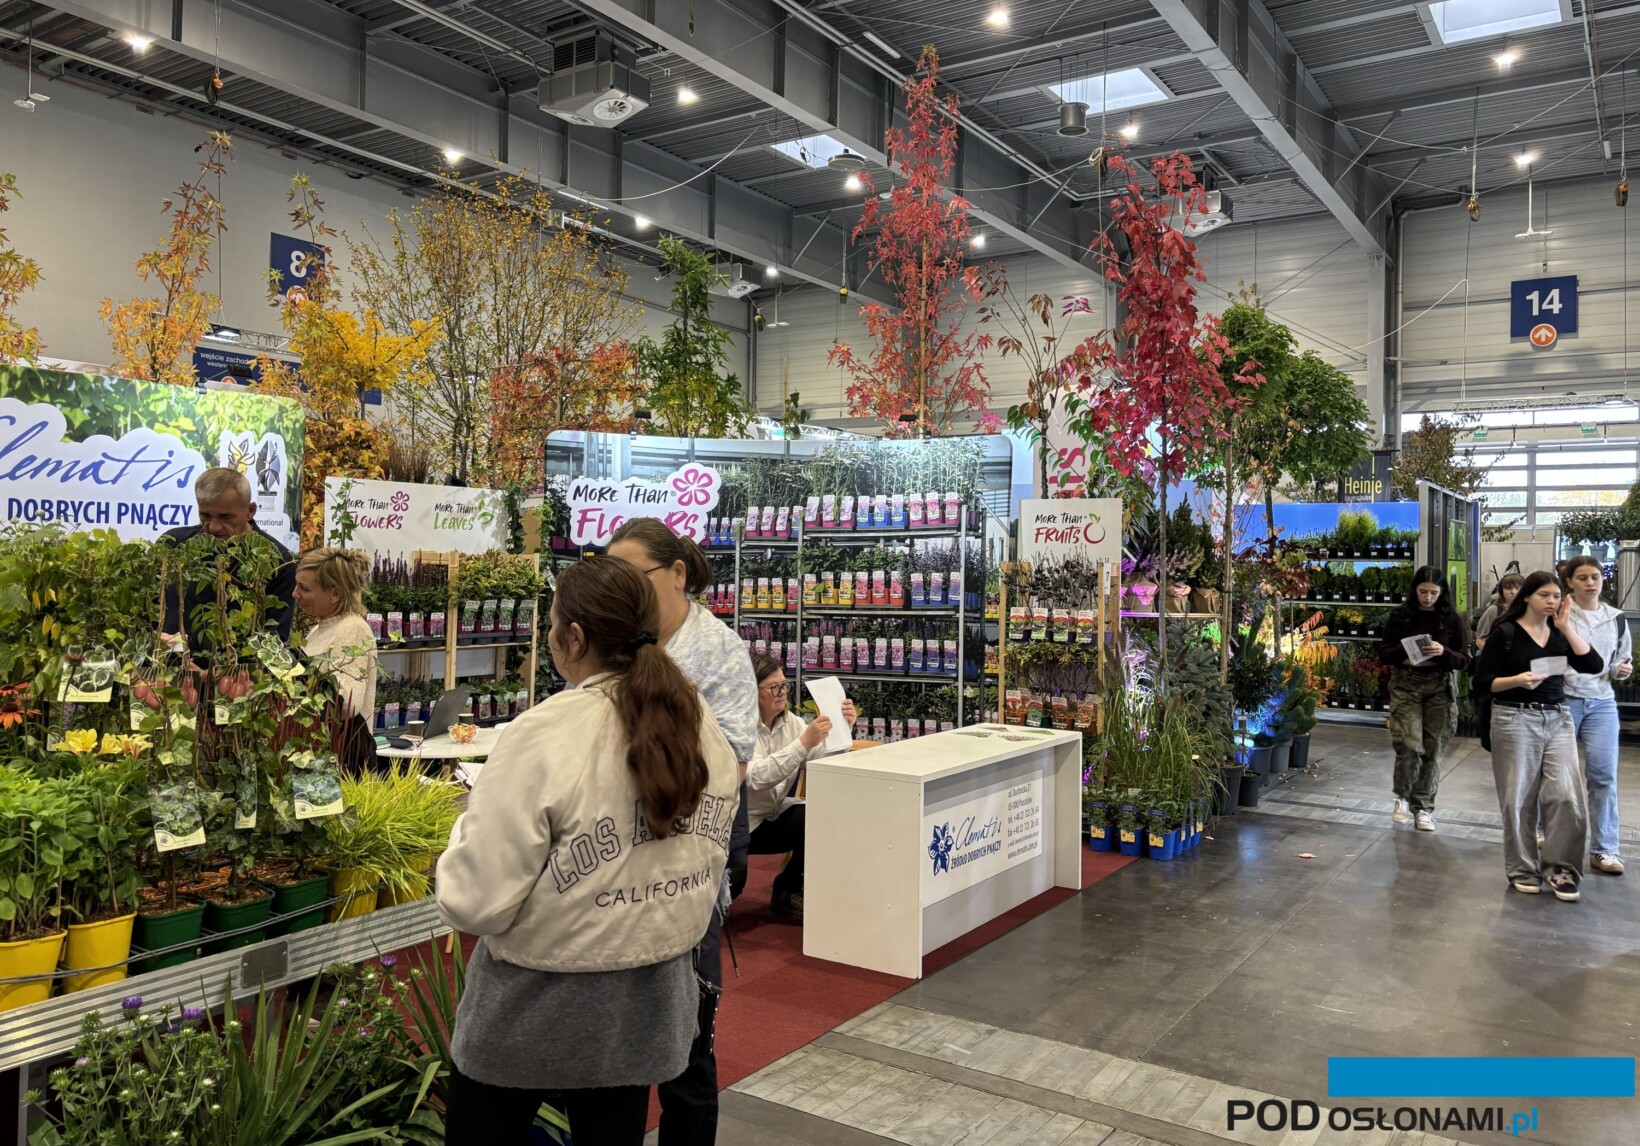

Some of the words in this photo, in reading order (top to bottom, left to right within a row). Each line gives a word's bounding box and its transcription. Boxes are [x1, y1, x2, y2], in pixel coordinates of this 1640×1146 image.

[289, 250, 307, 278] 8
[1525, 288, 1563, 316] 14
[225, 356, 250, 365] zachod
[0, 415, 195, 492] lematis
[1344, 476, 1383, 503] Heinje
[8, 498, 110, 524] DOBRYCH
[117, 502, 193, 531] PNĄCZY
[955, 815, 1002, 851] Clematis
[549, 816, 621, 894] LOS
[595, 867, 711, 908] CALIFORNIA
